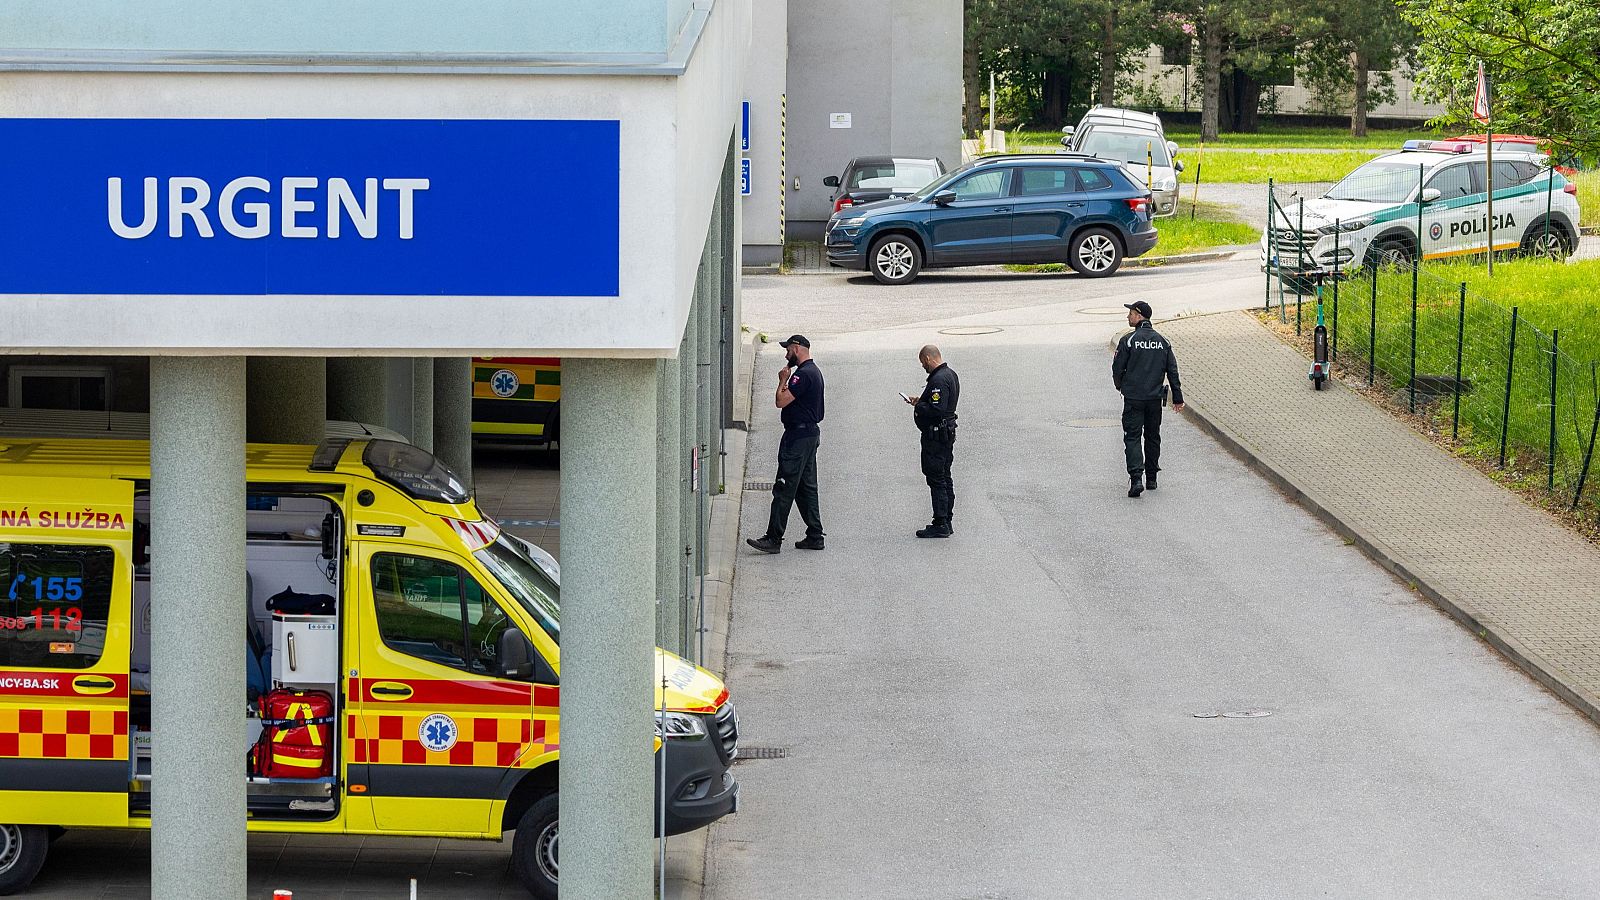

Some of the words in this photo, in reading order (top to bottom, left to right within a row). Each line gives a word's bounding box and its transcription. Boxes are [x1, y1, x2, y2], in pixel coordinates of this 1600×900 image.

[107, 177, 430, 239] URGENT
[1450, 212, 1516, 238] POLÍCIA
[1134, 339, 1164, 350] POLÍCIA
[1, 507, 32, 527] NÁ
[39, 508, 126, 530] SLUŽBA
[30, 576, 83, 601] 155
[30, 607, 83, 631] 112
